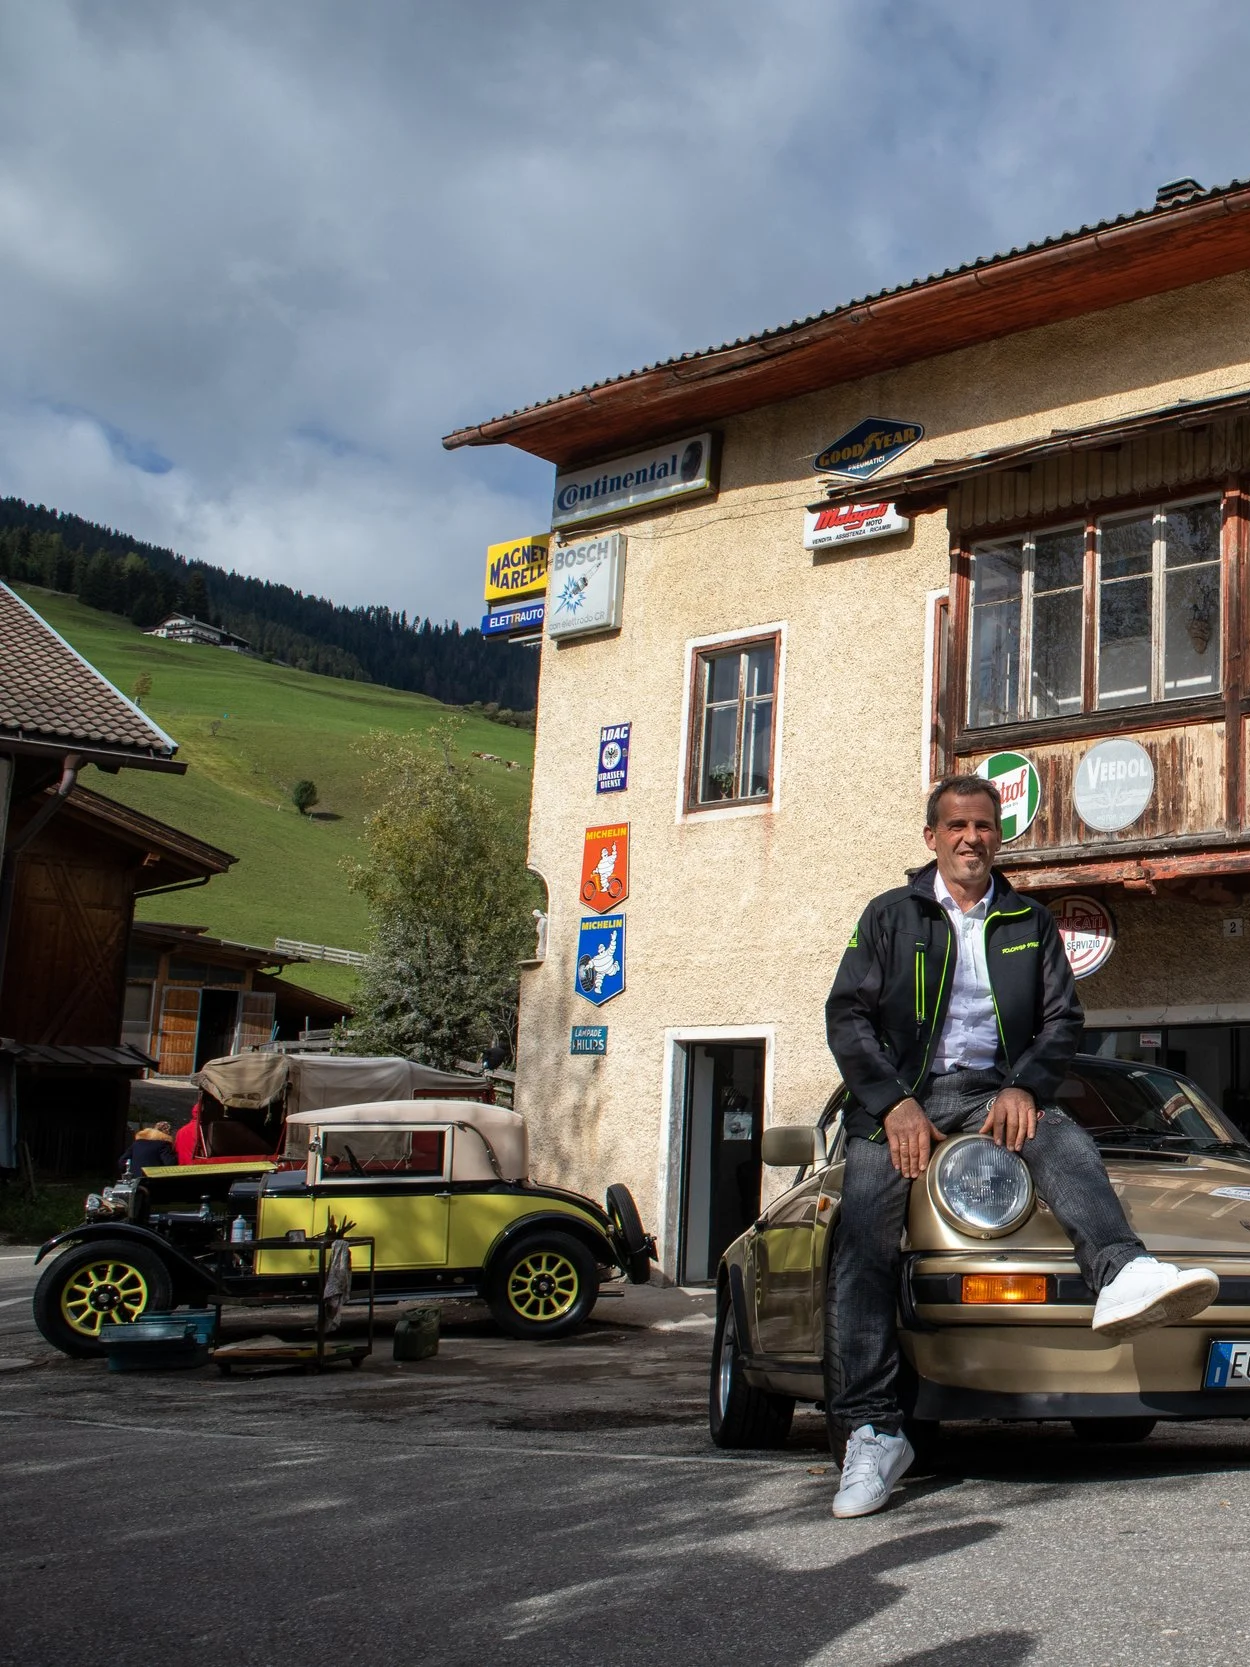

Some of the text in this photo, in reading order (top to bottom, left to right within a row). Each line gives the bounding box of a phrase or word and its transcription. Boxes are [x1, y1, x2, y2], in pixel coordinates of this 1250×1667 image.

[848, 455, 885, 472] PNEUMATICI
[557, 454, 678, 511] Continental
[865, 518, 883, 528] MOTO
[812, 523, 892, 545] VENDITA ASSISTENZA RICAMBI
[490, 545, 548, 575] MAGNET
[554, 540, 609, 572] BOSCH
[490, 561, 547, 589] MARELL
[489, 608, 545, 628] ELETTRAUTO
[601, 726, 629, 743] ADAC
[1087, 757, 1148, 790] VEEDOL
[600, 779, 621, 789] DIENST
[1000, 769, 1027, 804] trol
[586, 826, 627, 841] MICHELIN
[581, 919, 622, 931] MICHELIN
[1056, 914, 1103, 931] DUCATI
[1230, 921, 1236, 933] 2
[1066, 939, 1101, 951] SERVIZIO
[574, 1029, 602, 1038] LAMPADE
